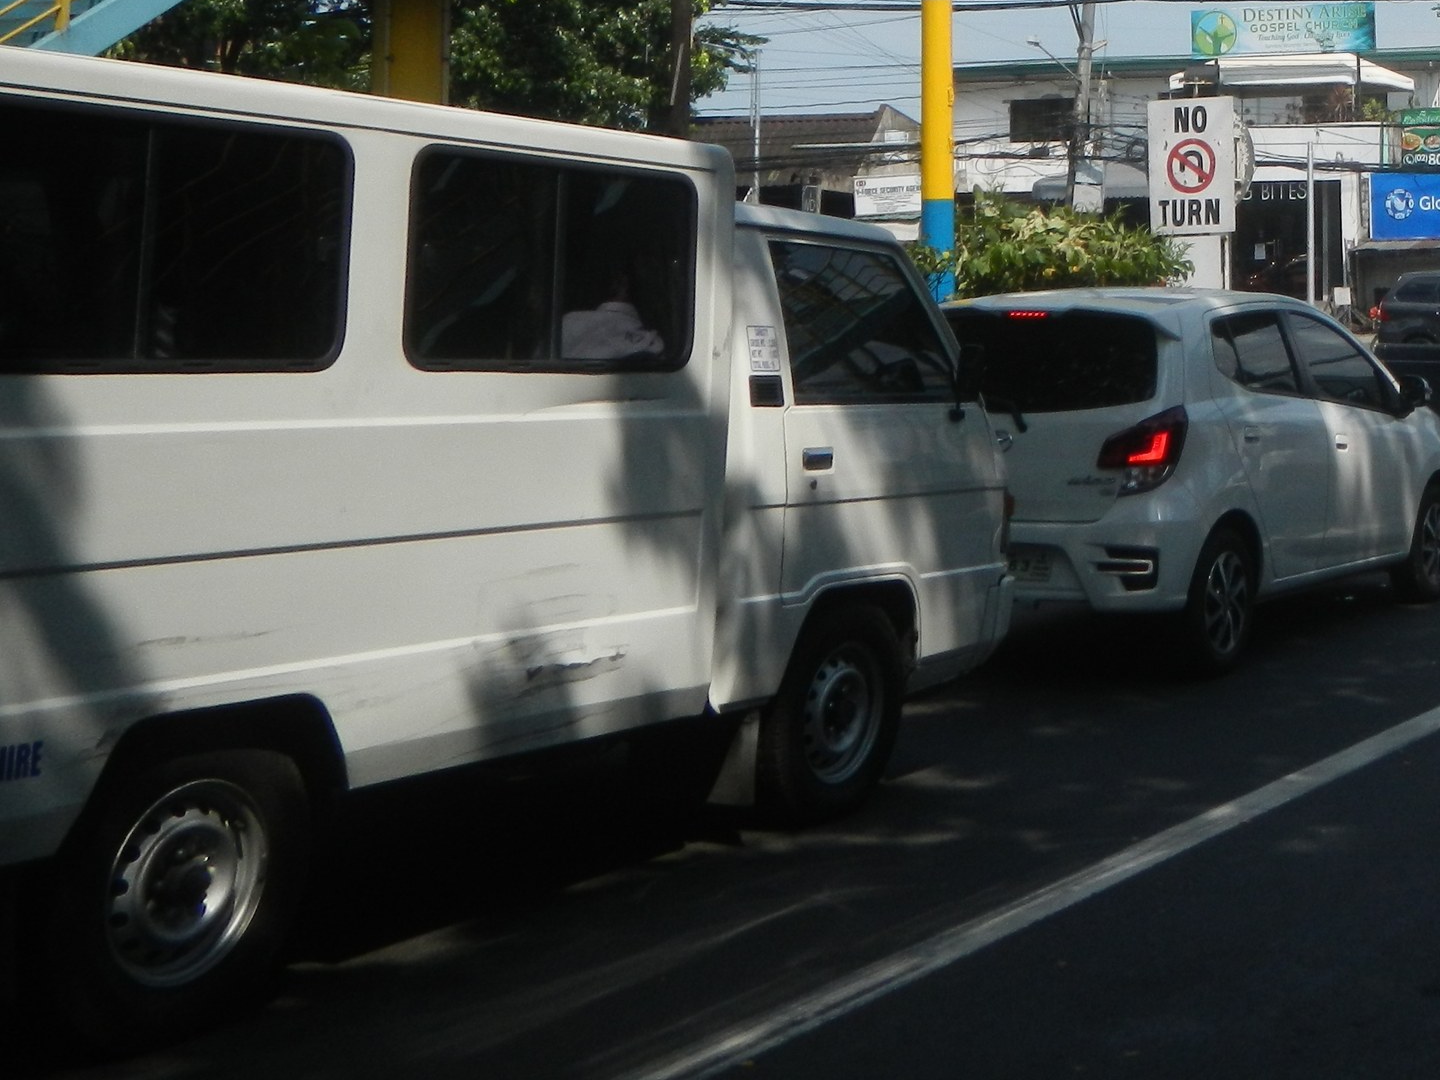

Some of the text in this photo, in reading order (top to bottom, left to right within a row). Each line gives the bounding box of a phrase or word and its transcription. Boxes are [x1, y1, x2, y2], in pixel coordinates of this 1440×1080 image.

[1243, 4, 1367, 23] DESTINY ARISE
[1250, 22, 1300, 33] GOSPEL
[1174, 106, 1207, 133] NO
[1159, 199, 1220, 227] TURN
